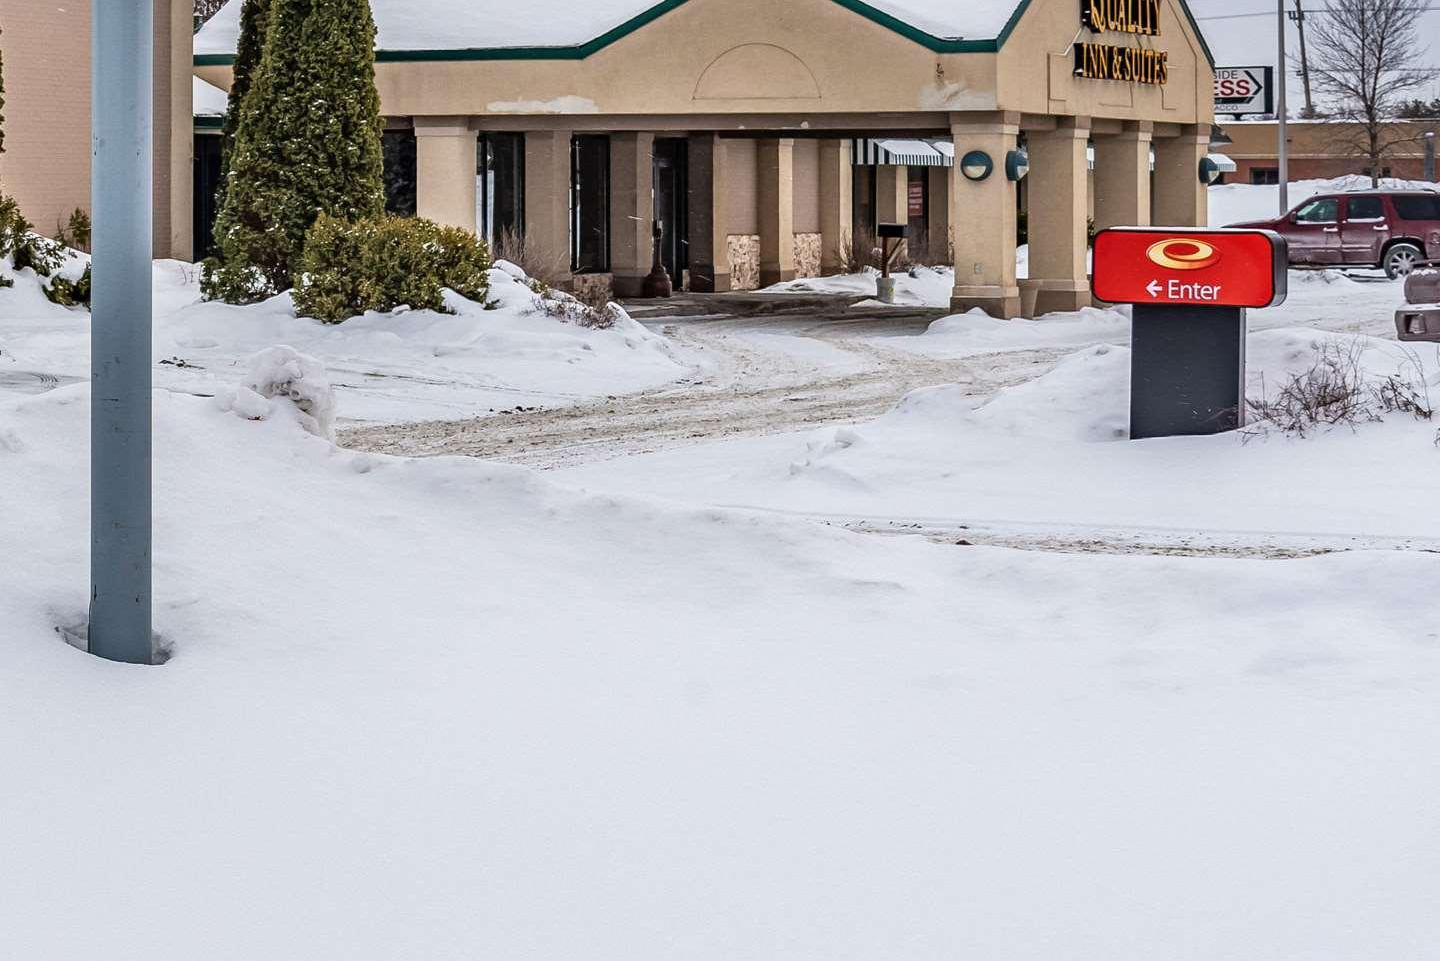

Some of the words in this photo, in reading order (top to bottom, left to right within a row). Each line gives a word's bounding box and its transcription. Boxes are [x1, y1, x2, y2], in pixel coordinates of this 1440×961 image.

[1082, 41, 1108, 78] INN
[1112, 46, 1123, 80] &
[1124, 47, 1168, 85] SUITES
[1168, 279, 1221, 300] Enter
